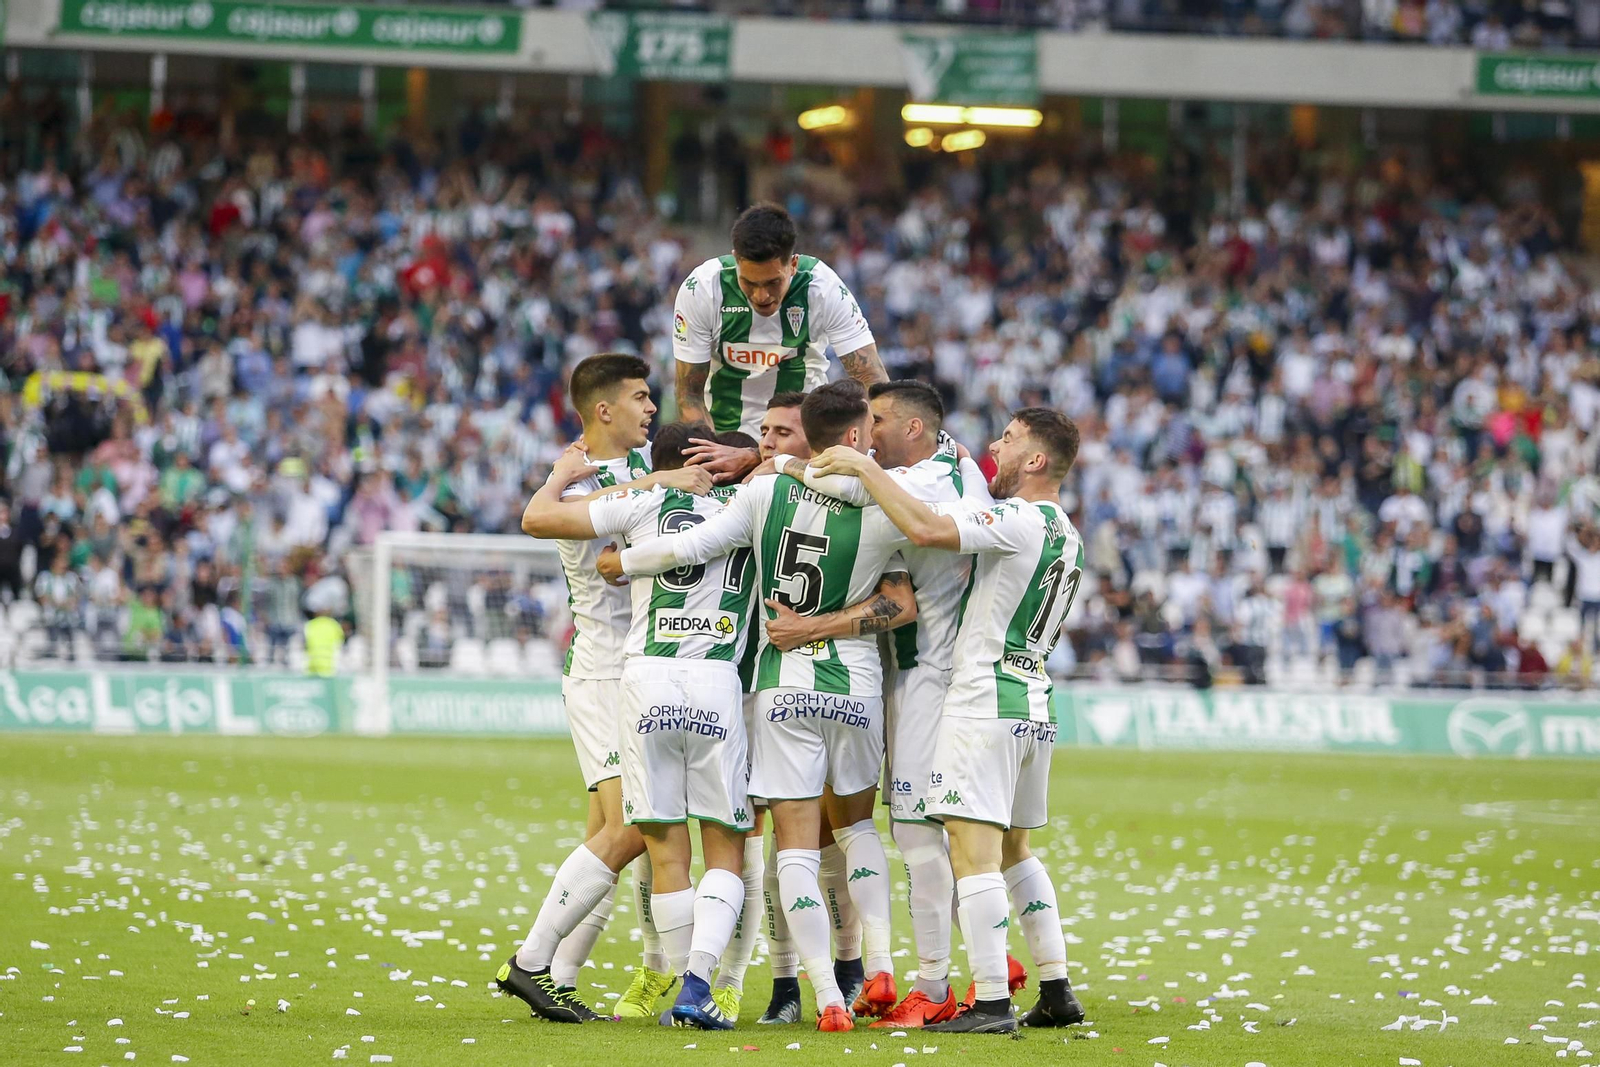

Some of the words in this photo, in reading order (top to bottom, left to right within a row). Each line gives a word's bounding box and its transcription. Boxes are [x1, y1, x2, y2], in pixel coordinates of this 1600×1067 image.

[727, 346, 783, 367] tano
[771, 525, 830, 617] 5
[1026, 557, 1083, 654] 11
[773, 693, 865, 715] CORHYUND
[660, 717, 727, 740] HYUNDAI
[795, 706, 871, 729] HYUNDAI
[828, 888, 843, 930] CORDOBA
